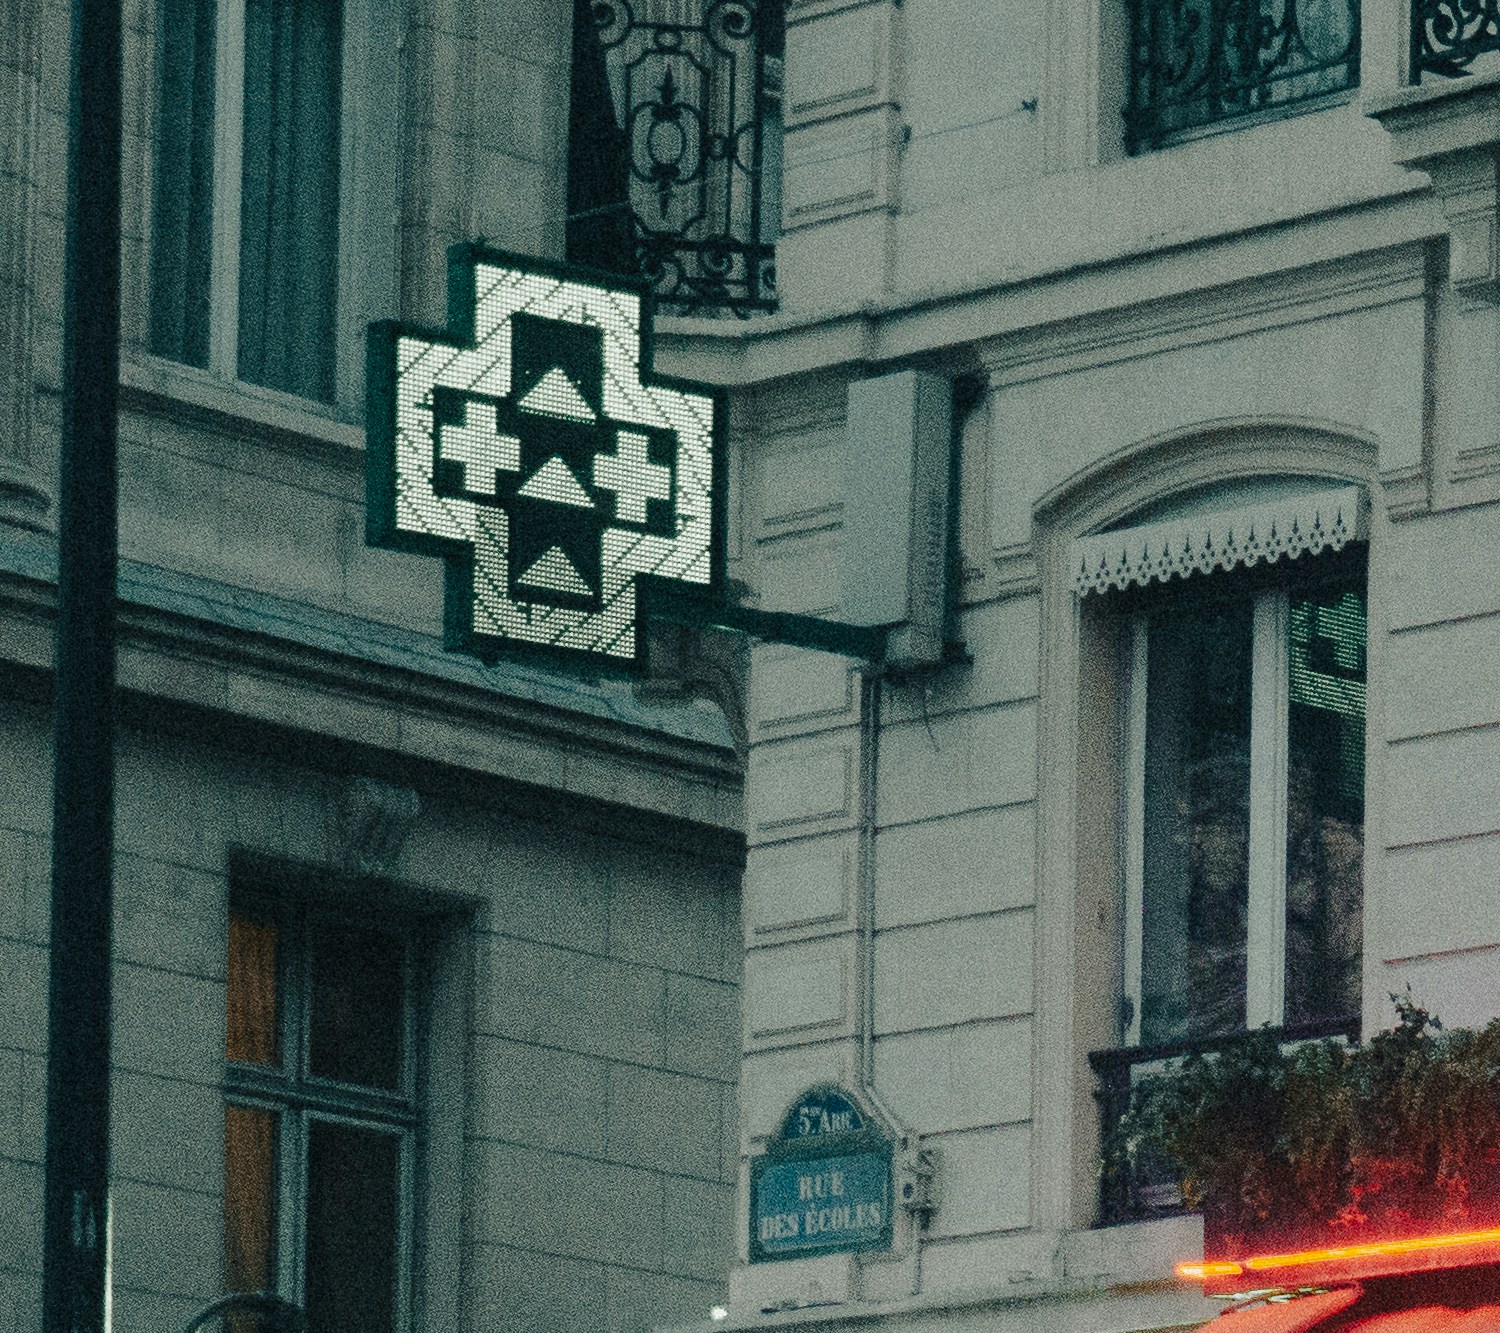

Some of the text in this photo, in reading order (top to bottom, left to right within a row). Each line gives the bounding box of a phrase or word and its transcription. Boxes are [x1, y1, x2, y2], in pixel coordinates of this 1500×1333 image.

[799, 1171, 844, 1200] RUE
[760, 1201, 881, 1240] DES ÉCOLES
